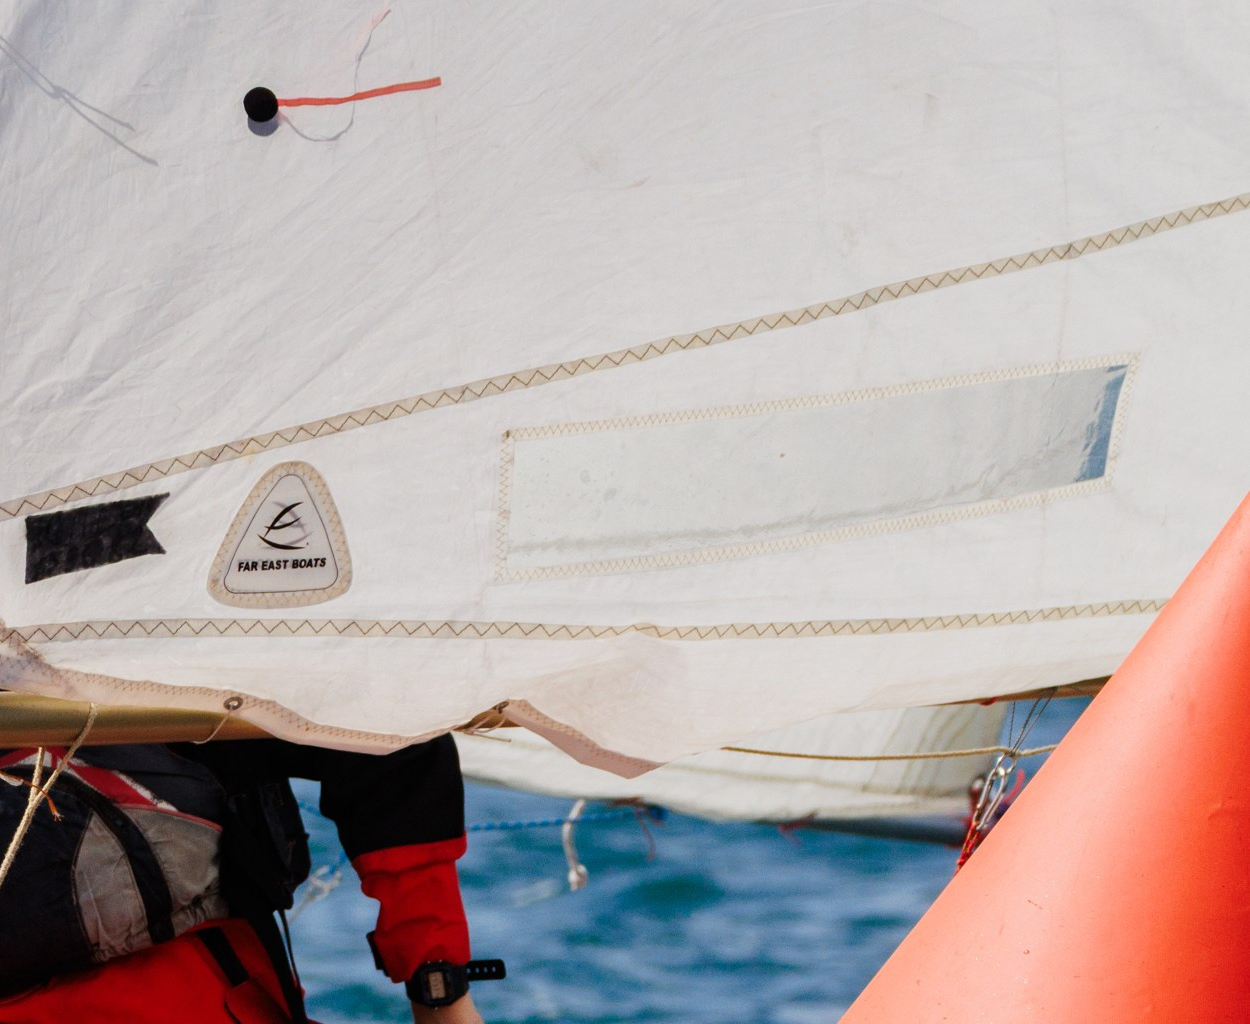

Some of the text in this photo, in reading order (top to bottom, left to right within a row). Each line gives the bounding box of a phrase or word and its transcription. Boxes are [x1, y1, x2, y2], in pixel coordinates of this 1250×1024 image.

[238, 557, 327, 572] FAR EAST BOATS
